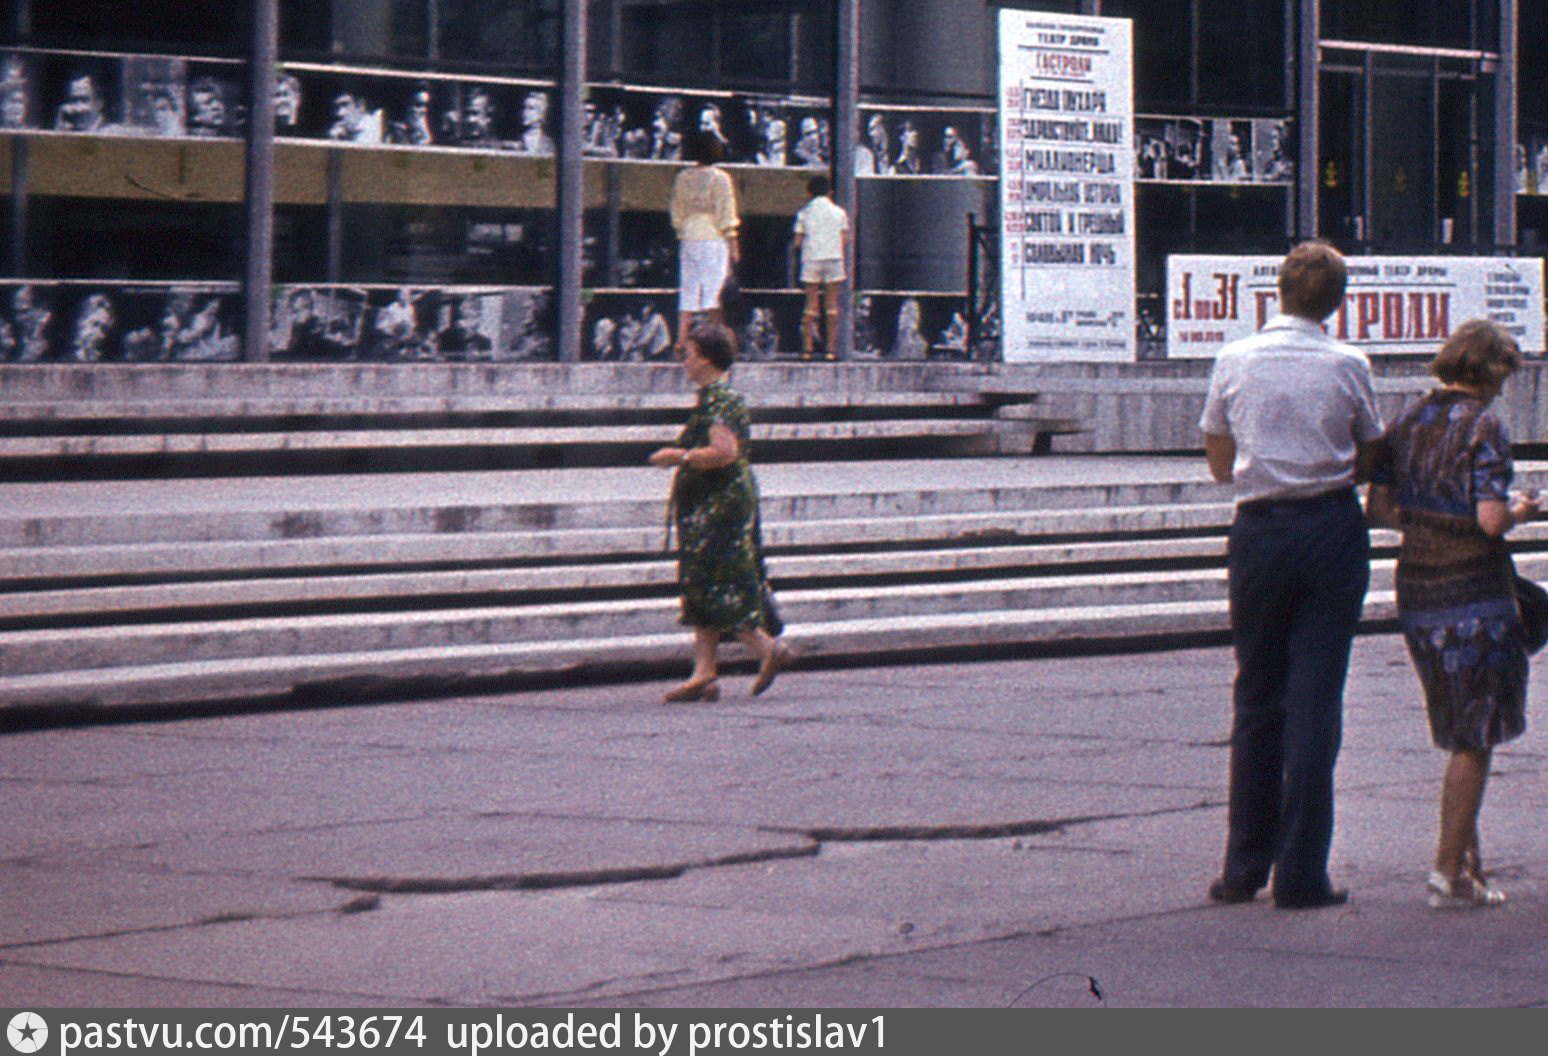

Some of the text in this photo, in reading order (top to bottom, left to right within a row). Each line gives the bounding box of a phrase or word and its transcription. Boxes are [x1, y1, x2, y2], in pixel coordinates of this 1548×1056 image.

[1036, 52, 1092, 72] ГАСТРОЛИ
[1025, 149, 1115, 174] МИЛЛИОНЕРША
[1024, 209, 1062, 233] СВЯТОЙ
[1067, 212, 1076, 233] И
[1078, 209, 1124, 235] ГРЕШНЫЙ
[1212, 272, 1240, 320] 31
[1254, 291, 1450, 340] ГТРОЛИ
